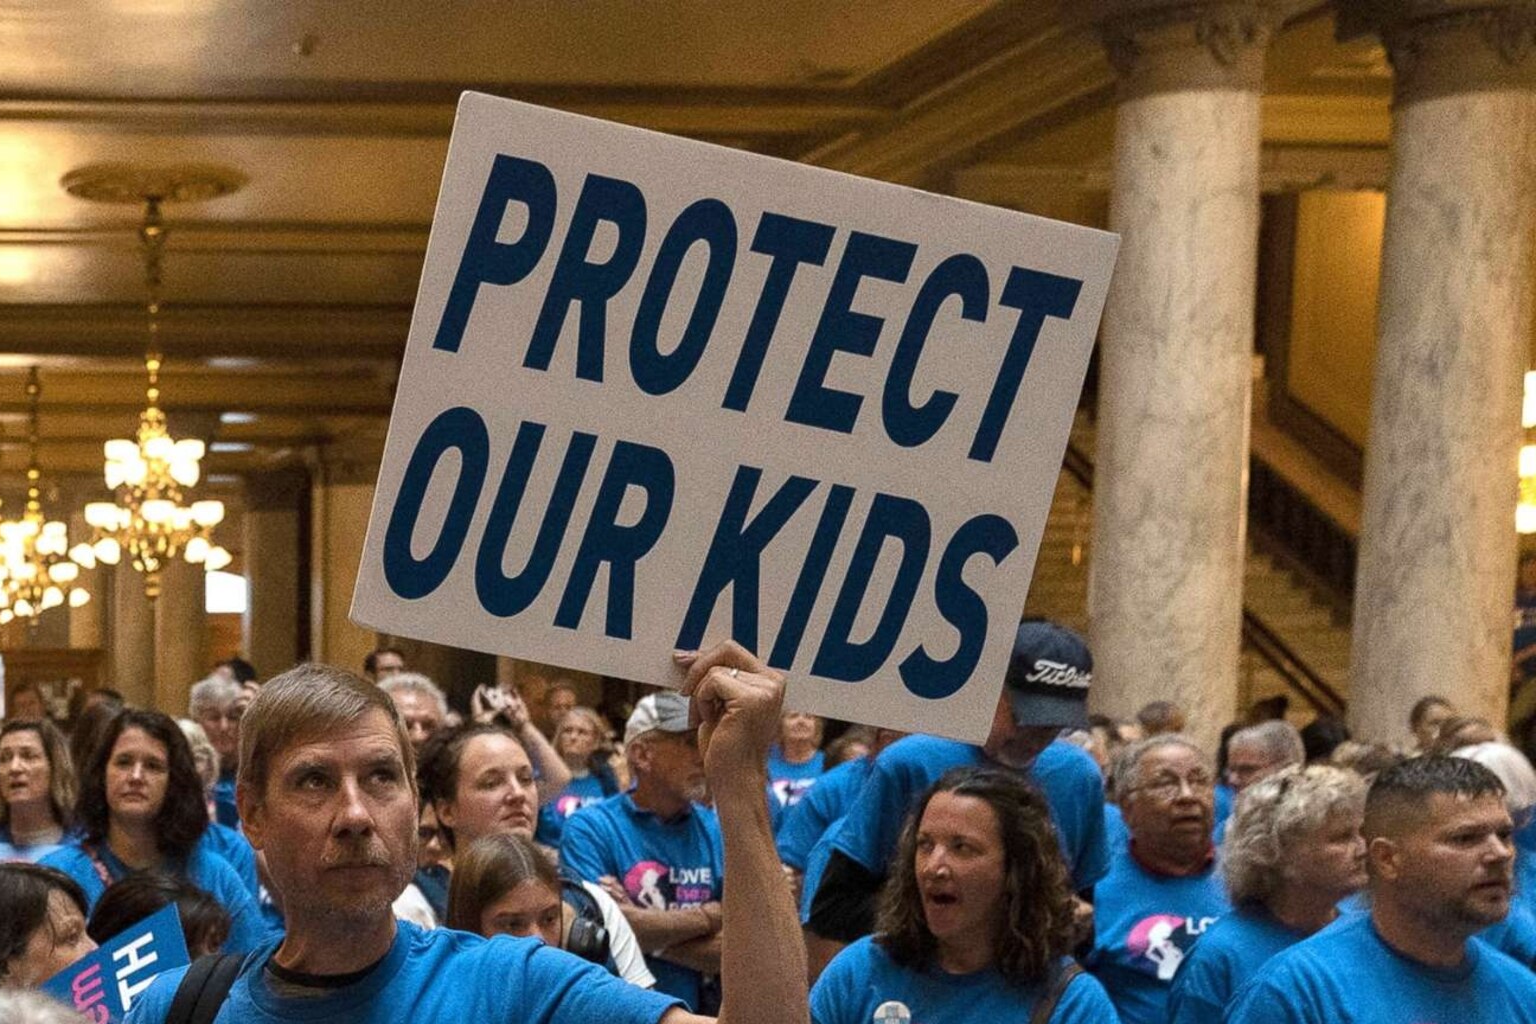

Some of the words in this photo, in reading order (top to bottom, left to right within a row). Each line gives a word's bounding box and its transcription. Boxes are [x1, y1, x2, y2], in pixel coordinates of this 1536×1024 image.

[432, 154, 1084, 463] PROTECT
[382, 406, 676, 640] OUR
[675, 465, 1019, 700] KIDS
[669, 867, 712, 884] LOVE
[112, 931, 158, 1012] TH
